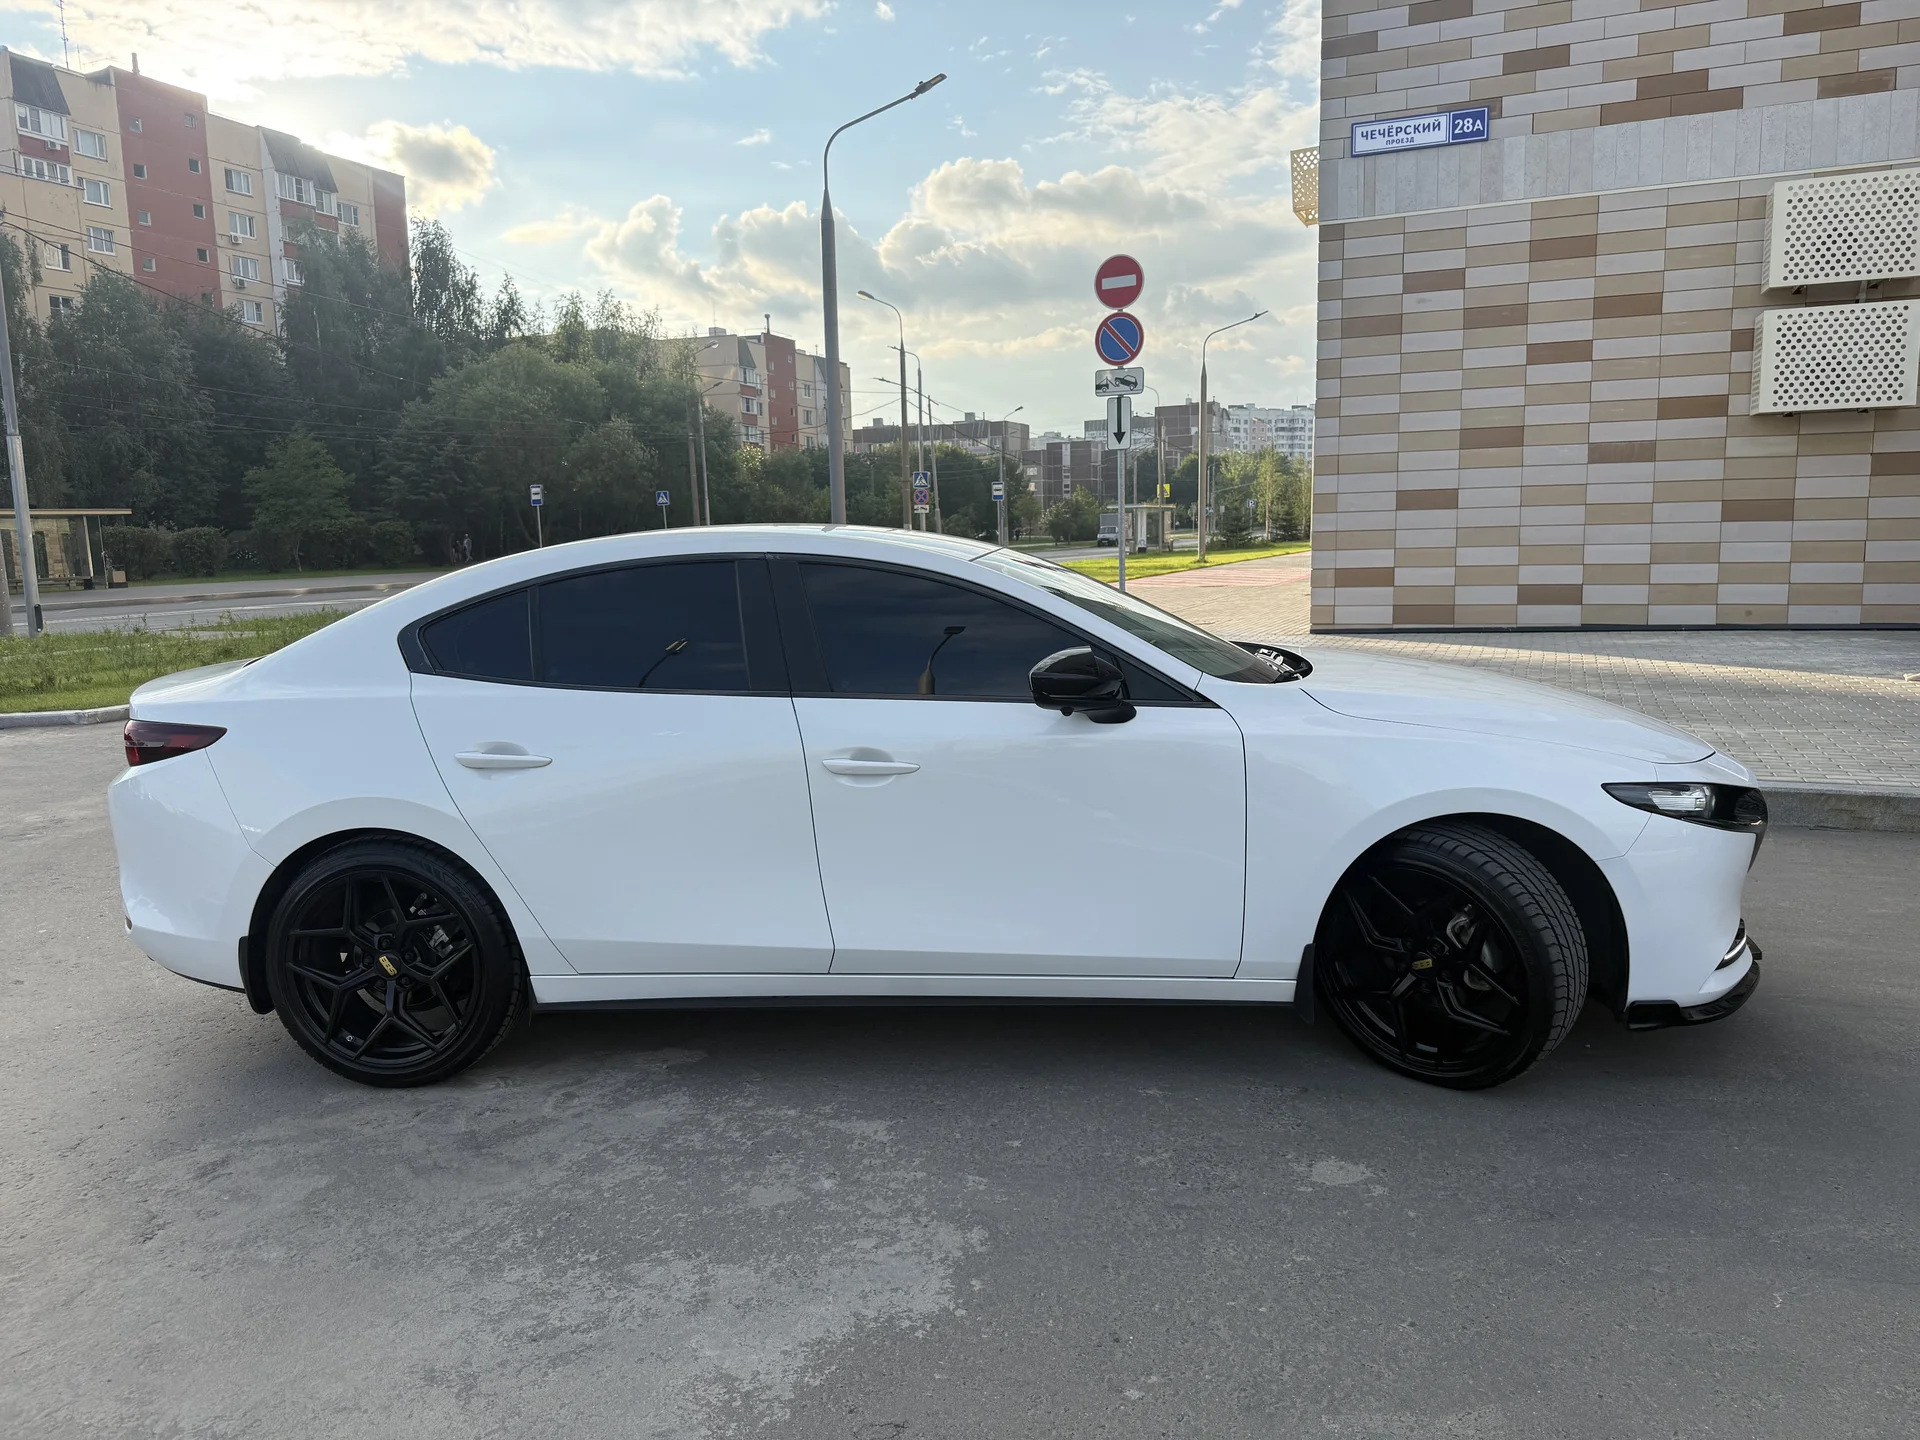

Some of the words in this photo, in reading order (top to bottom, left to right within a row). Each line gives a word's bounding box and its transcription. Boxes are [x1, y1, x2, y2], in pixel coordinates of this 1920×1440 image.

[1360, 119, 1441, 140] ЧЕЧЁРСКИЙ
[1454, 118, 1483, 134] 28А
[1385, 136, 1415, 146] ПРОЕЗД
